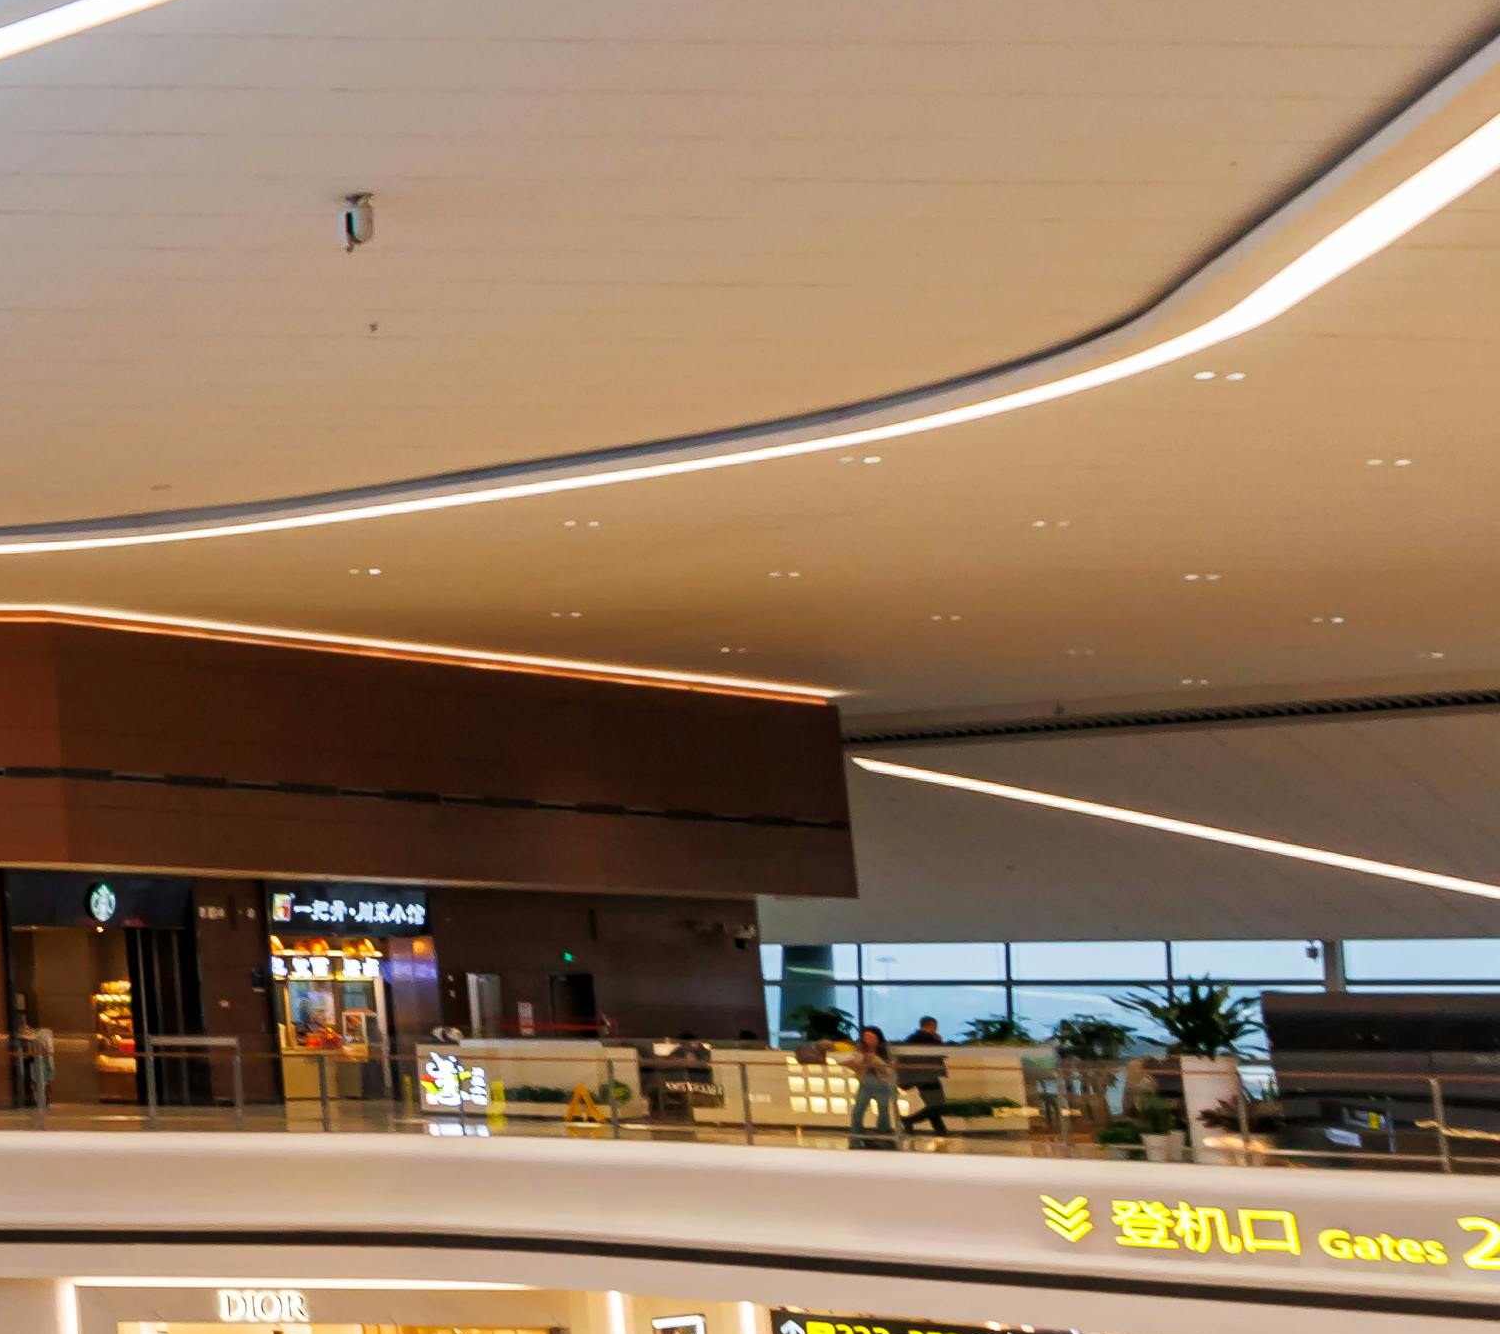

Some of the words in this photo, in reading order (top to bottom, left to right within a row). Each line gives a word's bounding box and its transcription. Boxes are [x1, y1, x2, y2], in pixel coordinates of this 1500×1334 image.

[1111, 1199, 1301, 1255] 登机口
[1318, 1228, 1449, 1265] Gates
[216, 1289, 309, 1322] DIOR
